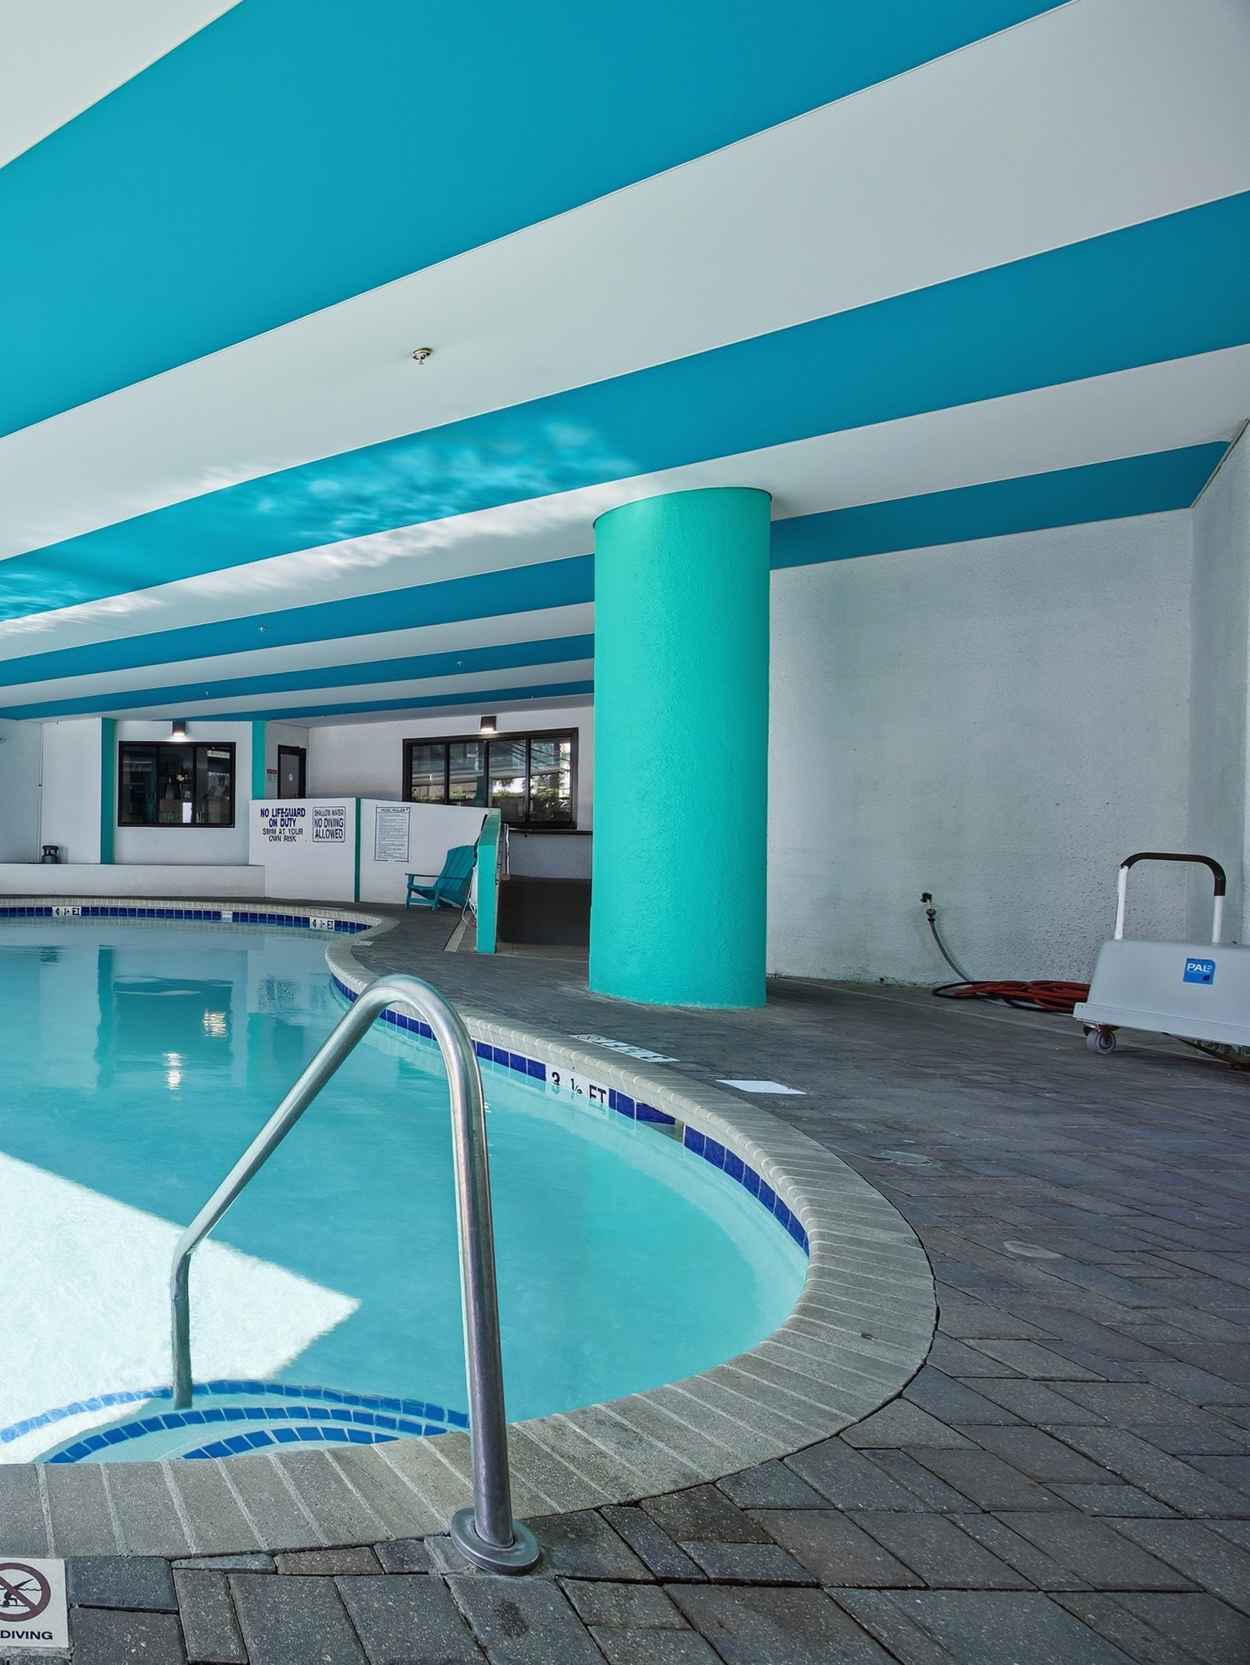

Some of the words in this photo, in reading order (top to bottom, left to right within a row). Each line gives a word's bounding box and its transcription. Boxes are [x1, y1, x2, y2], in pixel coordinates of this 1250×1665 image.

[260, 808, 269, 817] NO
[271, 808, 306, 817] LIFEGUARD
[268, 818, 278, 827] ON
[280, 818, 297, 827] DUTY
[314, 818, 323, 827] NO
[323, 818, 344, 827] DIVING
[288, 828, 304, 836] YOUR
[314, 829, 343, 839] ALLOWED
[1186, 962, 1212, 973] PAL
[551, 1071, 561, 1087] 3
[588, 1084, 607, 1104] FT
[0, 1628, 54, 1641] DIVING
